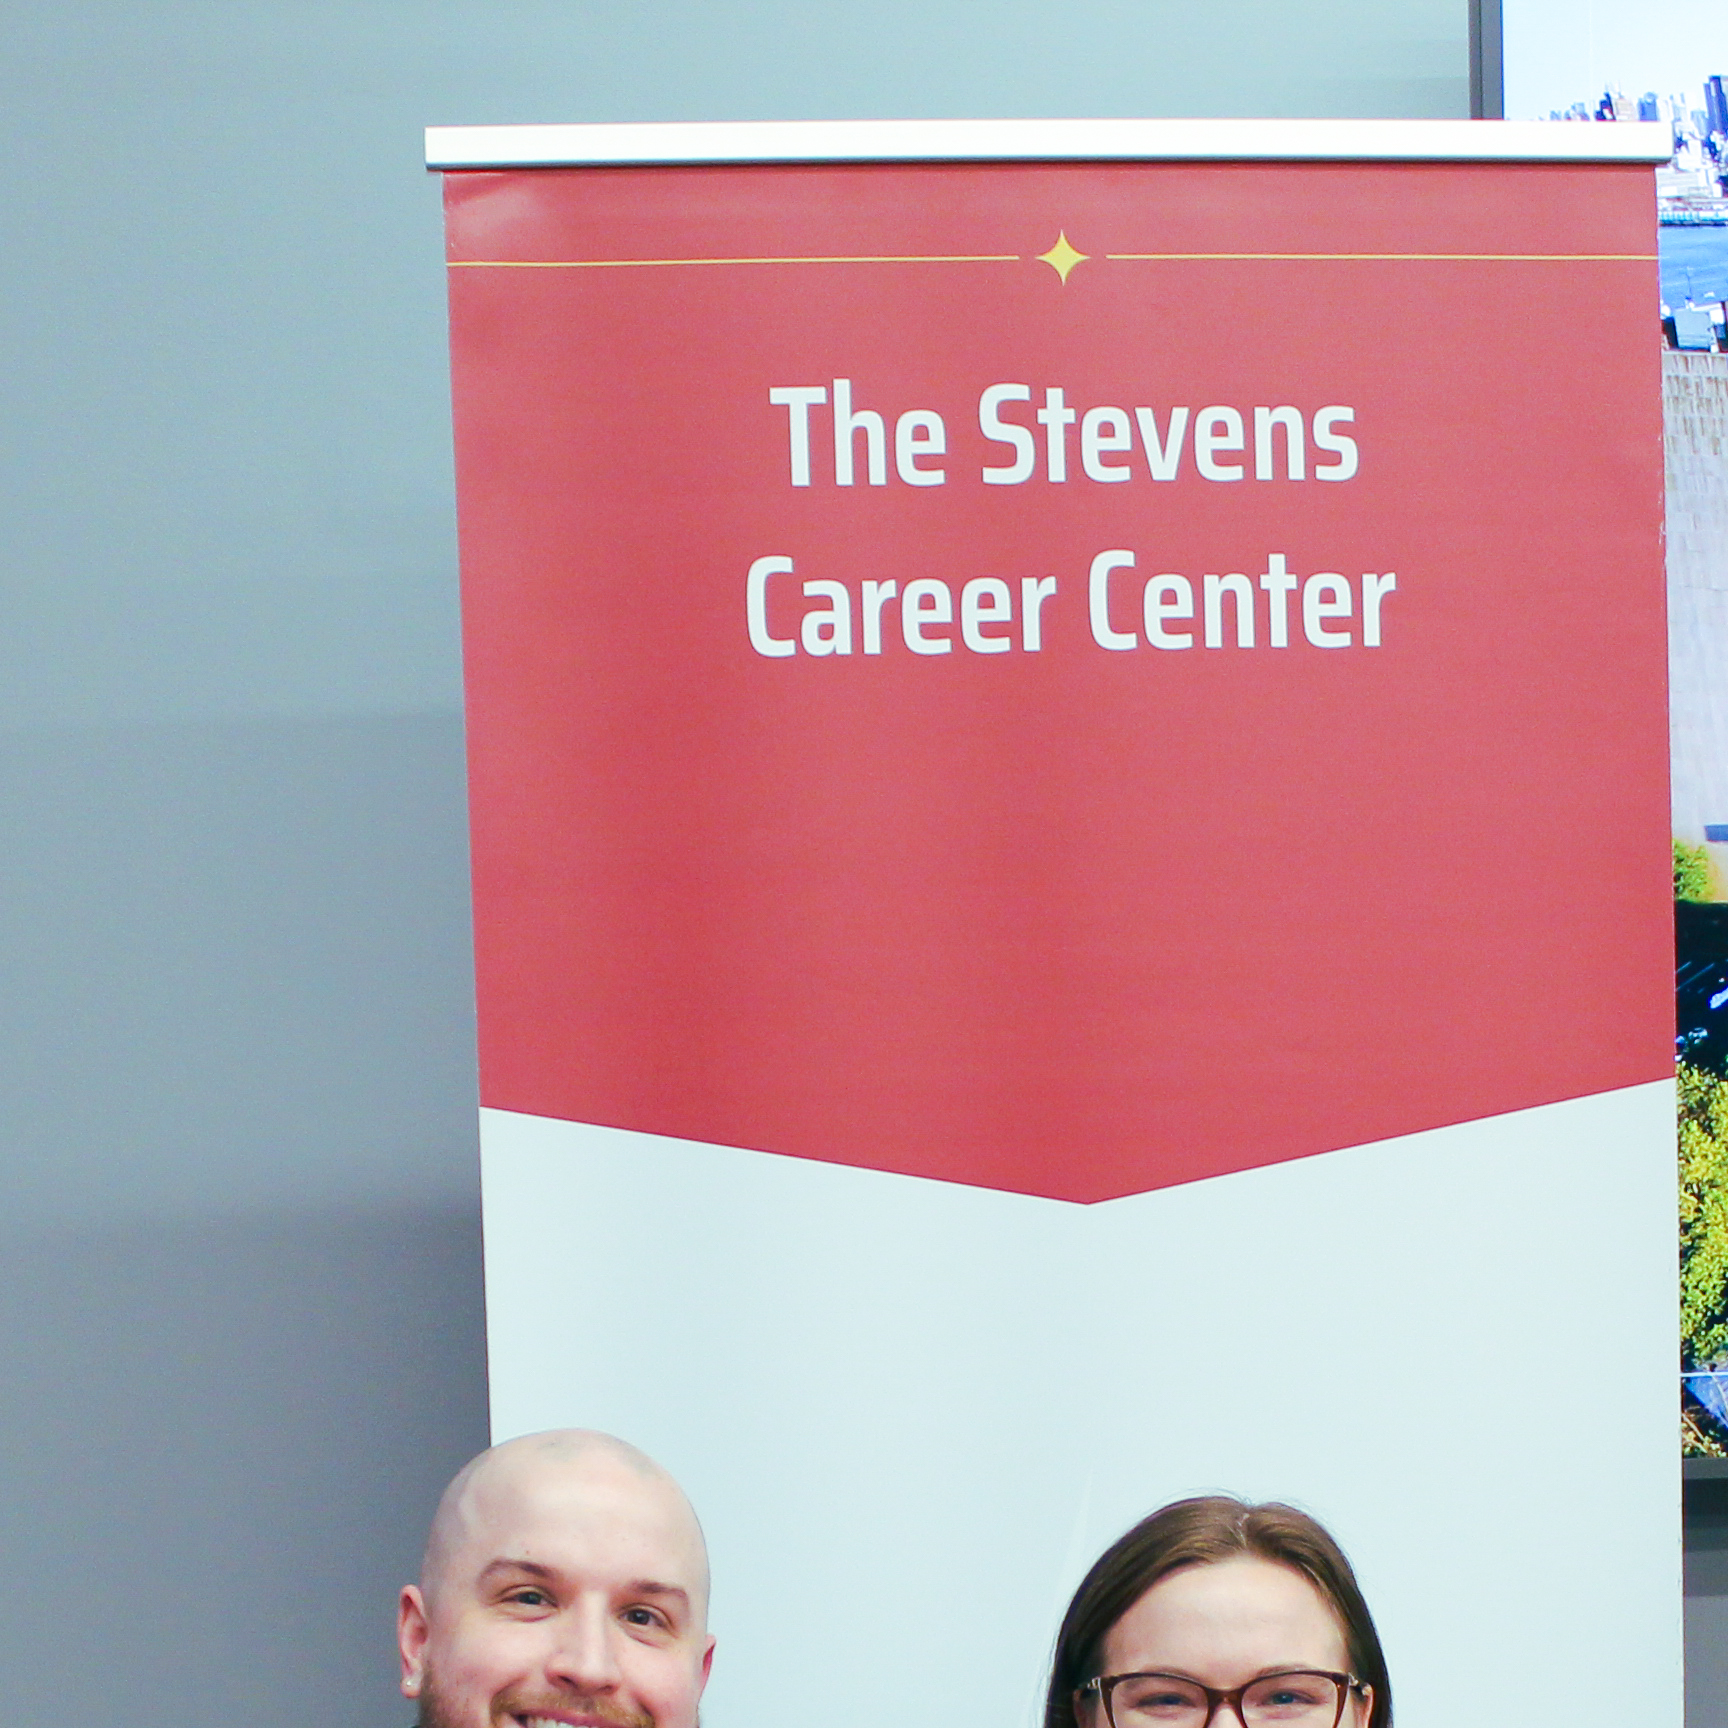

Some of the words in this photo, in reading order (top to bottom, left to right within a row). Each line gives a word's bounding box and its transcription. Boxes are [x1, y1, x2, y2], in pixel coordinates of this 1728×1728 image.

[770, 377, 946, 487] The
[978, 383, 1360, 485] Stevens
[746, 556, 1057, 658] Career
[1088, 550, 1397, 652] Center
